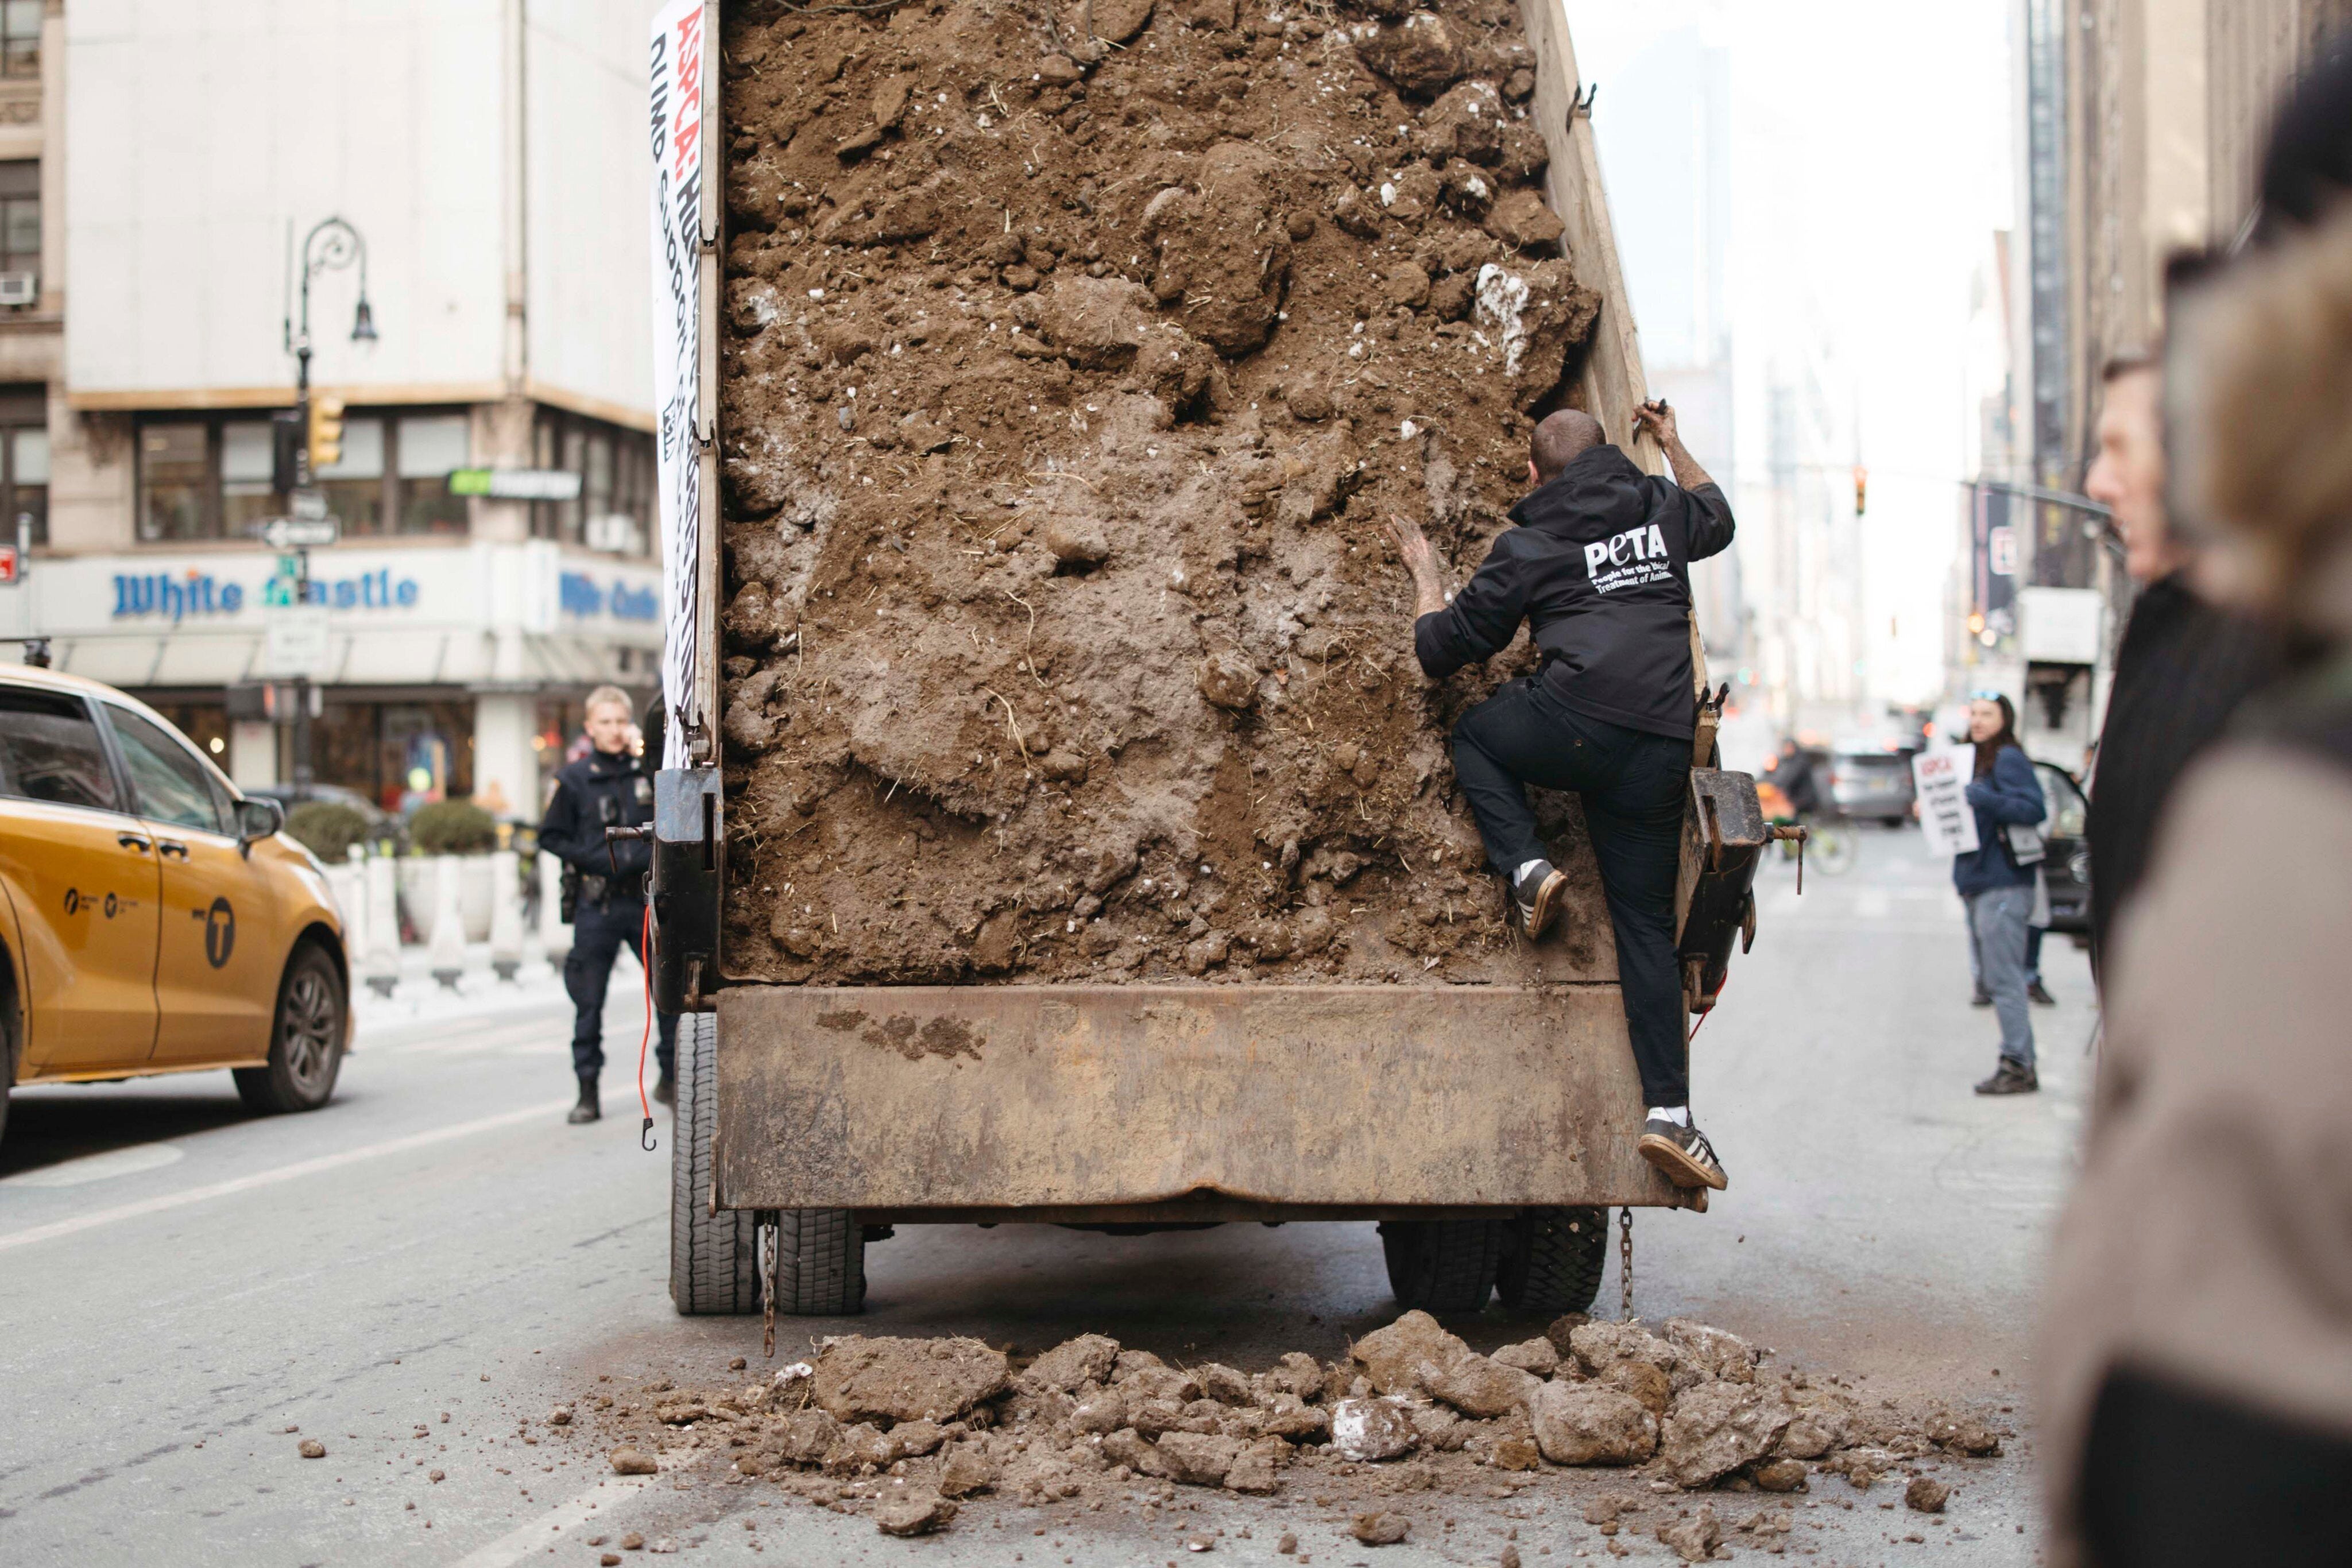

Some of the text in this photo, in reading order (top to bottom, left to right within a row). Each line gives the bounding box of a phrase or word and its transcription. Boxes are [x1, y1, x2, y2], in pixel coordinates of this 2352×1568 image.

[674, 3, 703, 182] ASPCA:
[659, 169, 688, 371] Support
[113, 566, 418, 622] White astle
[1591, 570, 1622, 585] People
[1621, 567, 1635, 576] for
[1635, 564, 1651, 573] the
[1595, 576, 1639, 594] Treatment
[1639, 573, 1648, 583] of
